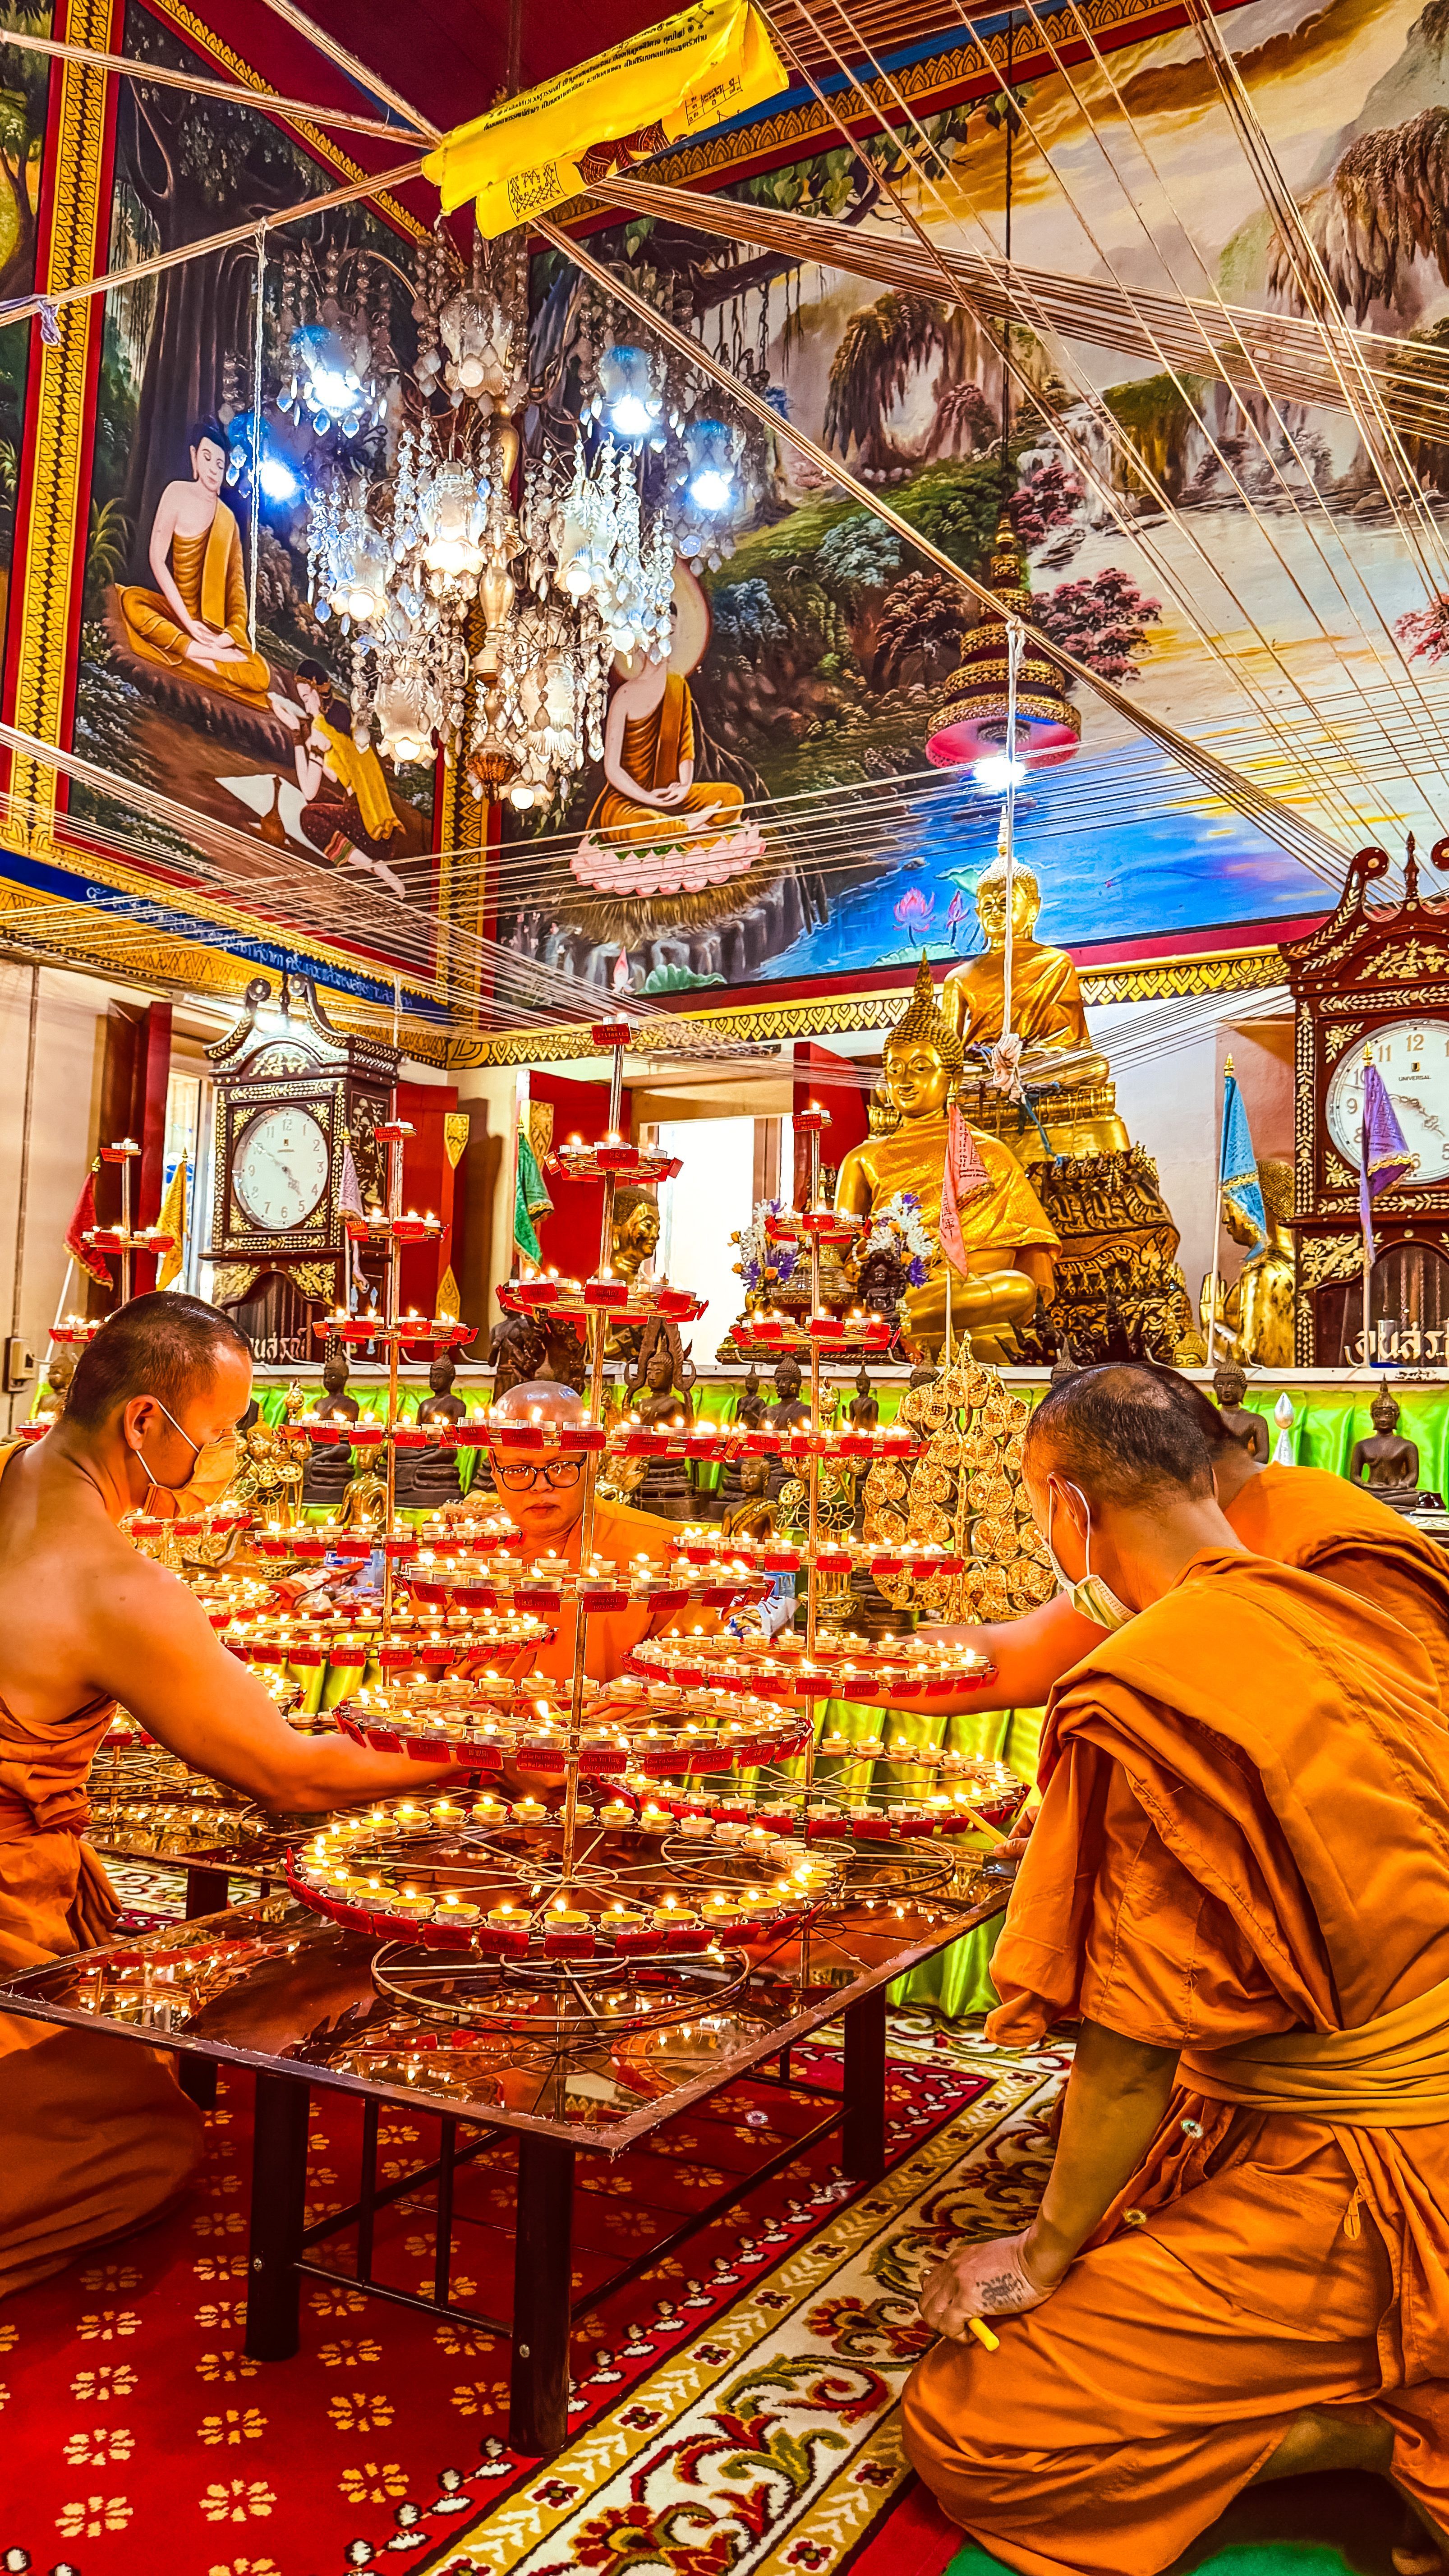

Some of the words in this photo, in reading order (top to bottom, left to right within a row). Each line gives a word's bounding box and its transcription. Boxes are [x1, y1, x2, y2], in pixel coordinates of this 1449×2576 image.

[1407, 1034, 1424, 1052] 12
[1379, 1044, 1391, 1062] 11
[1346, 1098, 1358, 1114] 9
[266, 1125, 275, 1138] 11
[282, 1118, 293, 1132] 12
[302, 1123, 307, 1136] 1
[313, 1139, 320, 1152] 2
[248, 1164, 256, 1177] 9
[317, 1161, 324, 1173] 3
[311, 1183, 318, 1196] 4
[264, 1201, 271, 1214] 7
[281, 1206, 288, 1219] 6
[298, 1200, 305, 1213] 5
